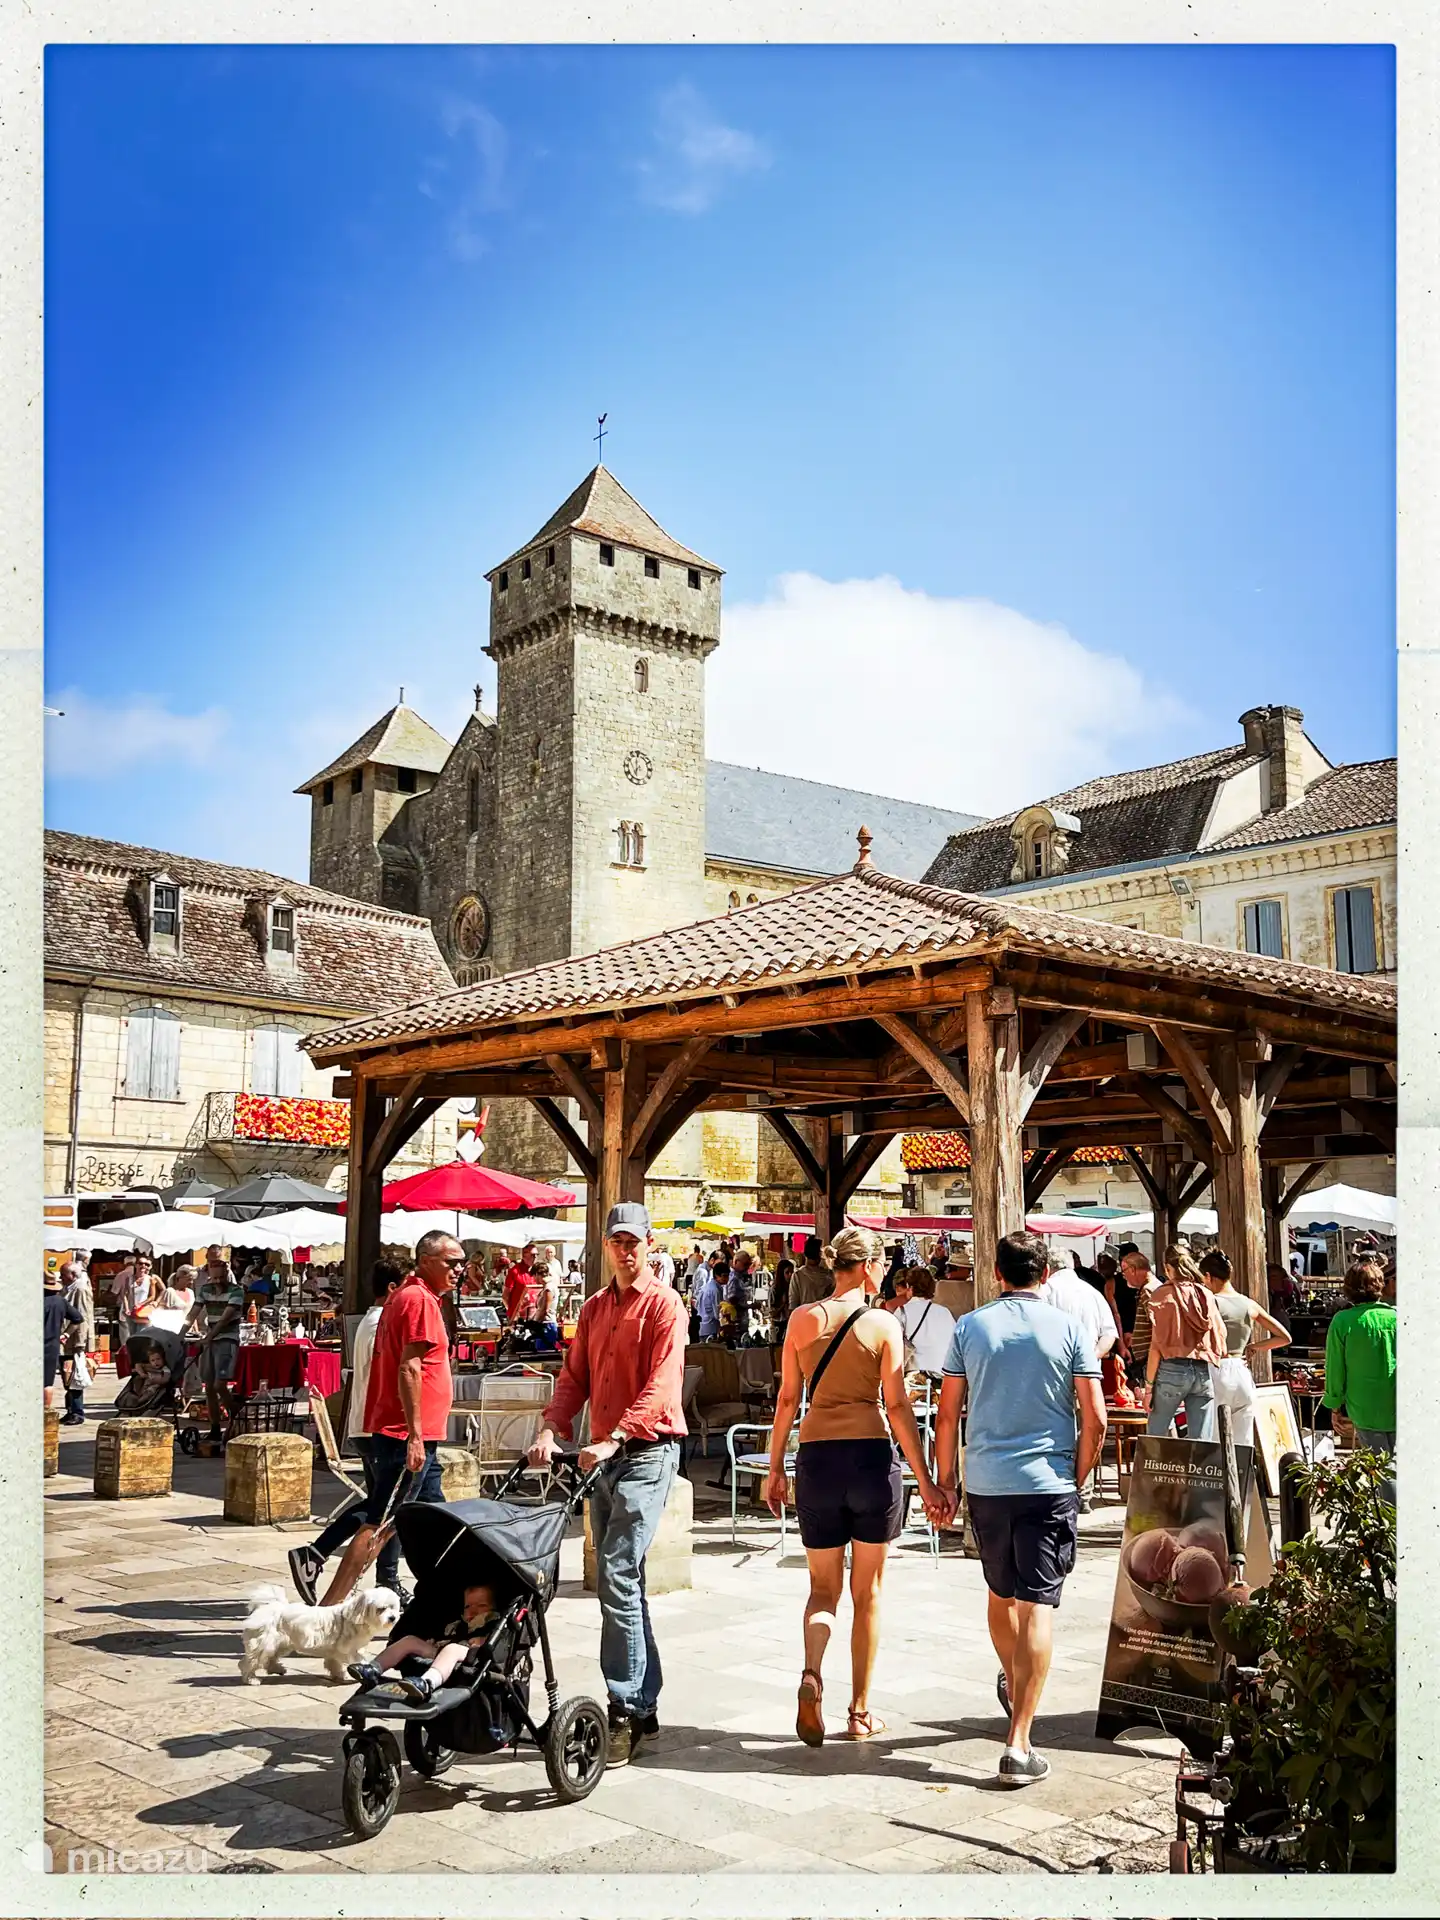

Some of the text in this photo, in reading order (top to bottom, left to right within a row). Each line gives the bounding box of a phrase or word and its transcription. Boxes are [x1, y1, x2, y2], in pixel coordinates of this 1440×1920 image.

[85, 1155, 145, 1177] PRESSE
[1143, 1459, 1223, 1477] Histoires De Gla
[1152, 1475, 1224, 1490] ARTISAN GLACIER
